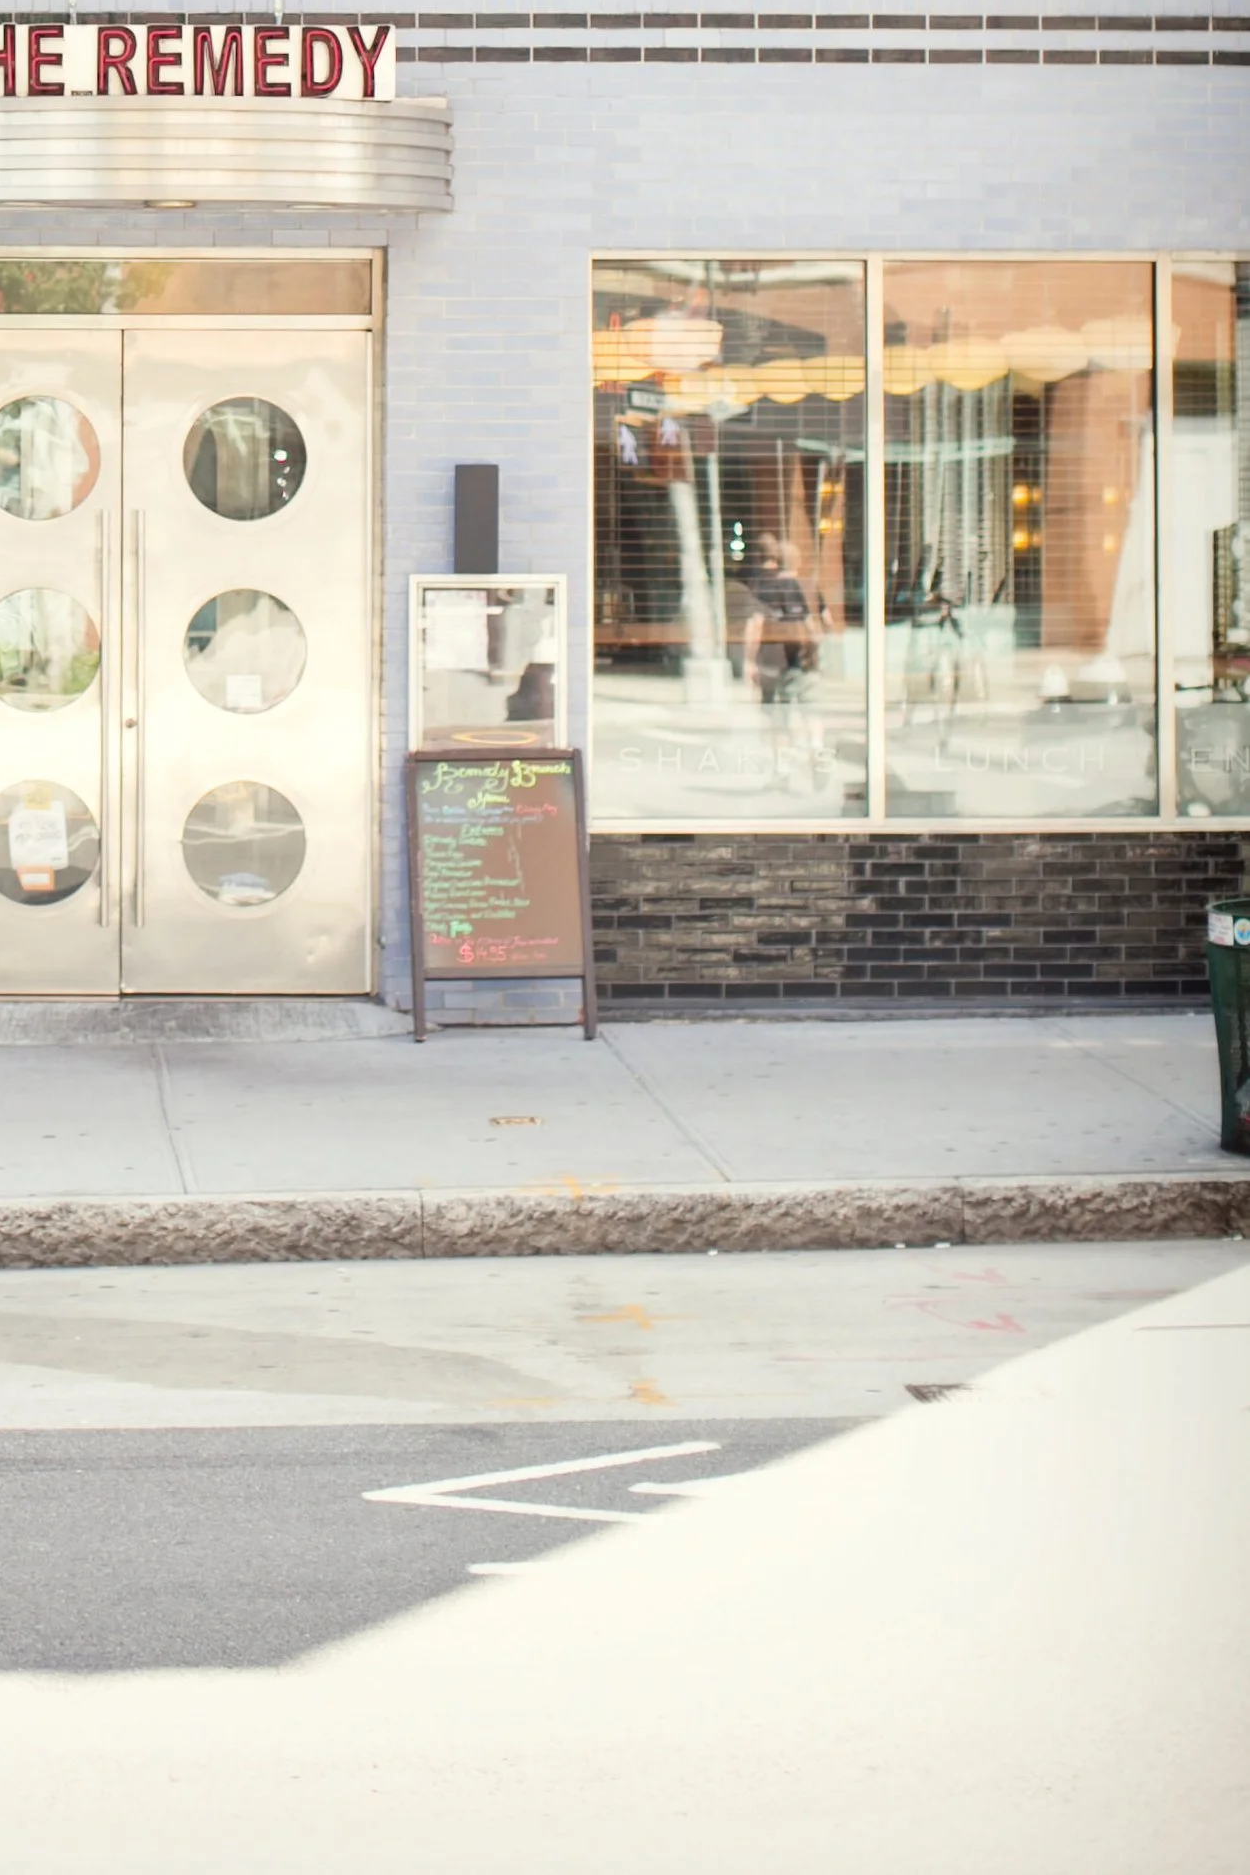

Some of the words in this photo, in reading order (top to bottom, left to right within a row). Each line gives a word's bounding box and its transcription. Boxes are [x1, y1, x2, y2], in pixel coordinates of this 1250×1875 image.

[97, 24, 392, 98] REMEDY
[618, 746, 839, 773] SHAKES
[933, 745, 1104, 773] LUNCH
[1191, 747, 1250, 773] EN
